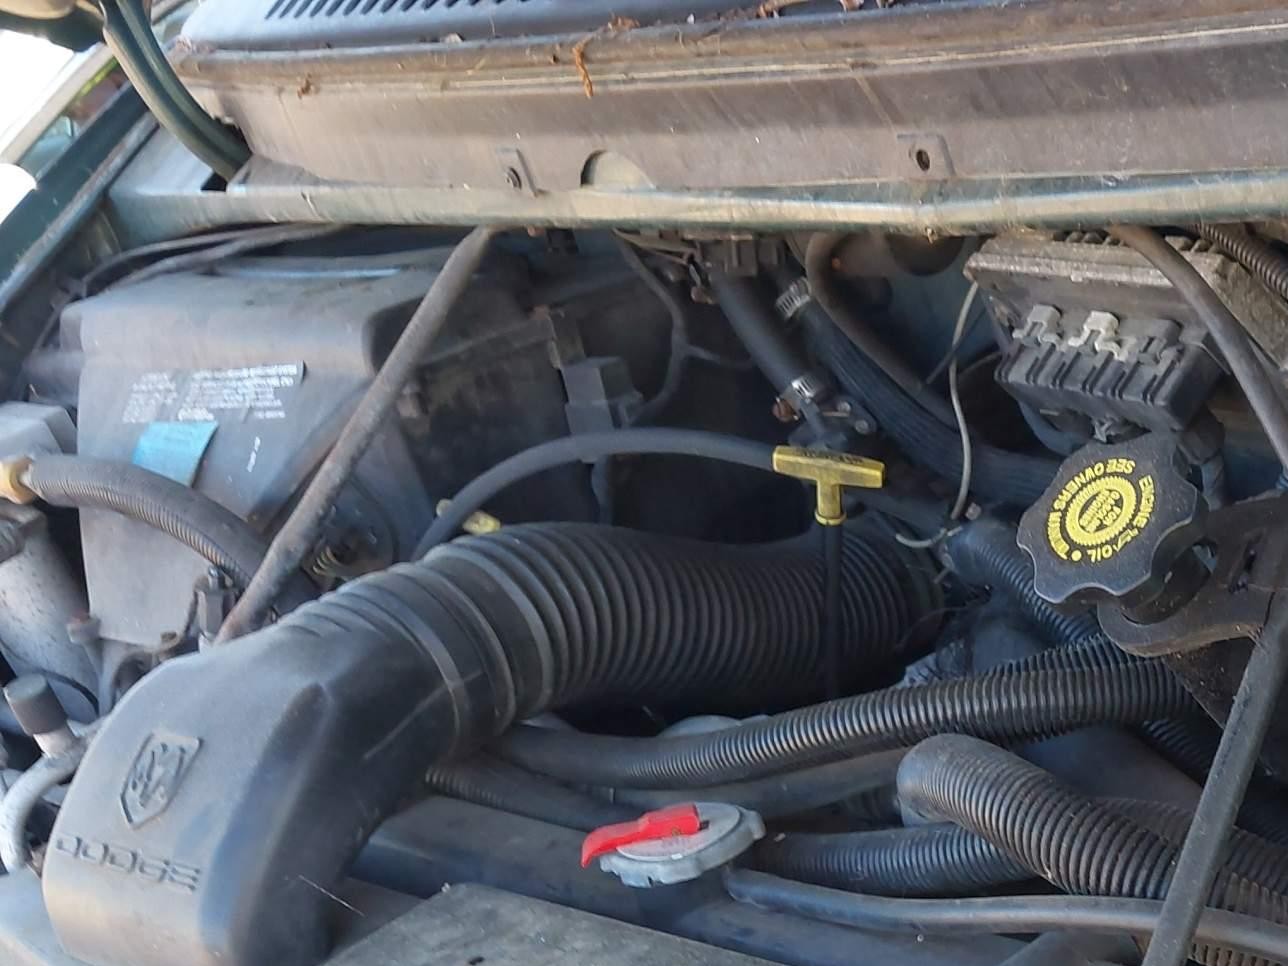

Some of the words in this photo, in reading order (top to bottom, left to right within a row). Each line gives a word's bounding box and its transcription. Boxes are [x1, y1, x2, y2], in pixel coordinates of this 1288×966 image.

[1105, 458, 1136, 474] SEE
[1053, 462, 1105, 510] OWNERS
[1087, 546, 1112, 563] OIL
[56, 836, 201, 892] DODGE
